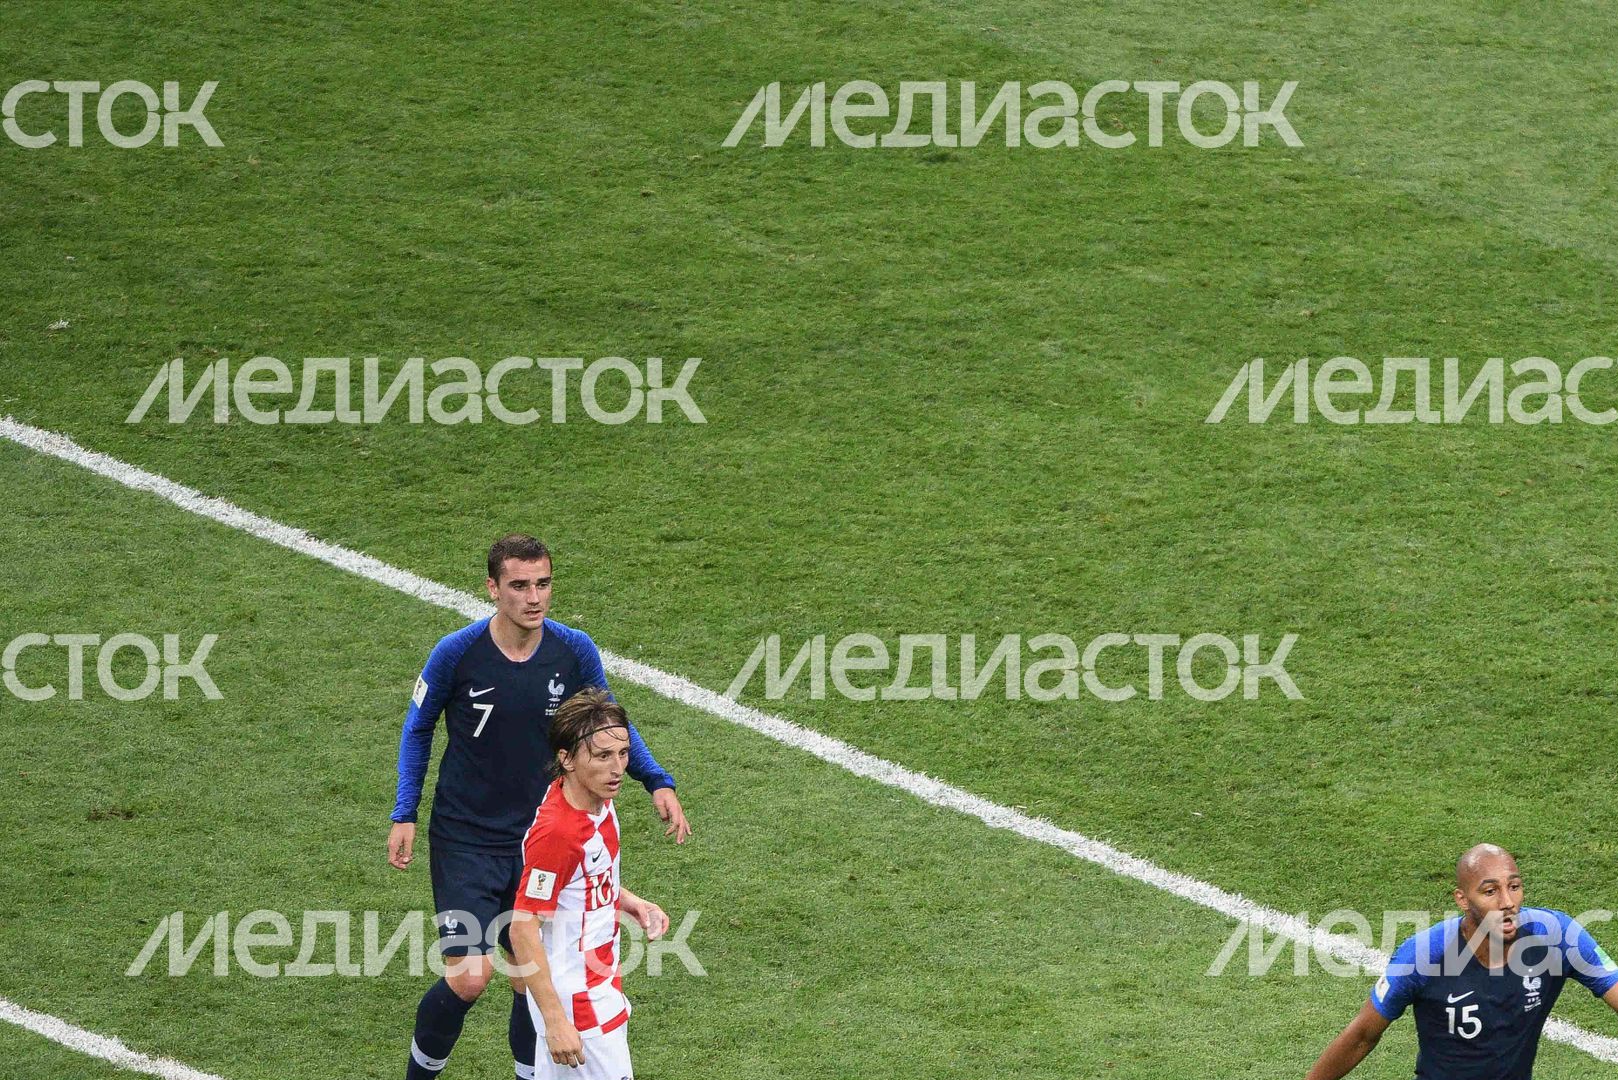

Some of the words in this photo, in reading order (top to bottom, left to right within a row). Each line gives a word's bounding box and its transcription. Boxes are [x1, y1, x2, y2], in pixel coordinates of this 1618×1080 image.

[472, 703, 495, 738] 7
[589, 869, 613, 910] 10
[1445, 1004, 1483, 1040] 15
